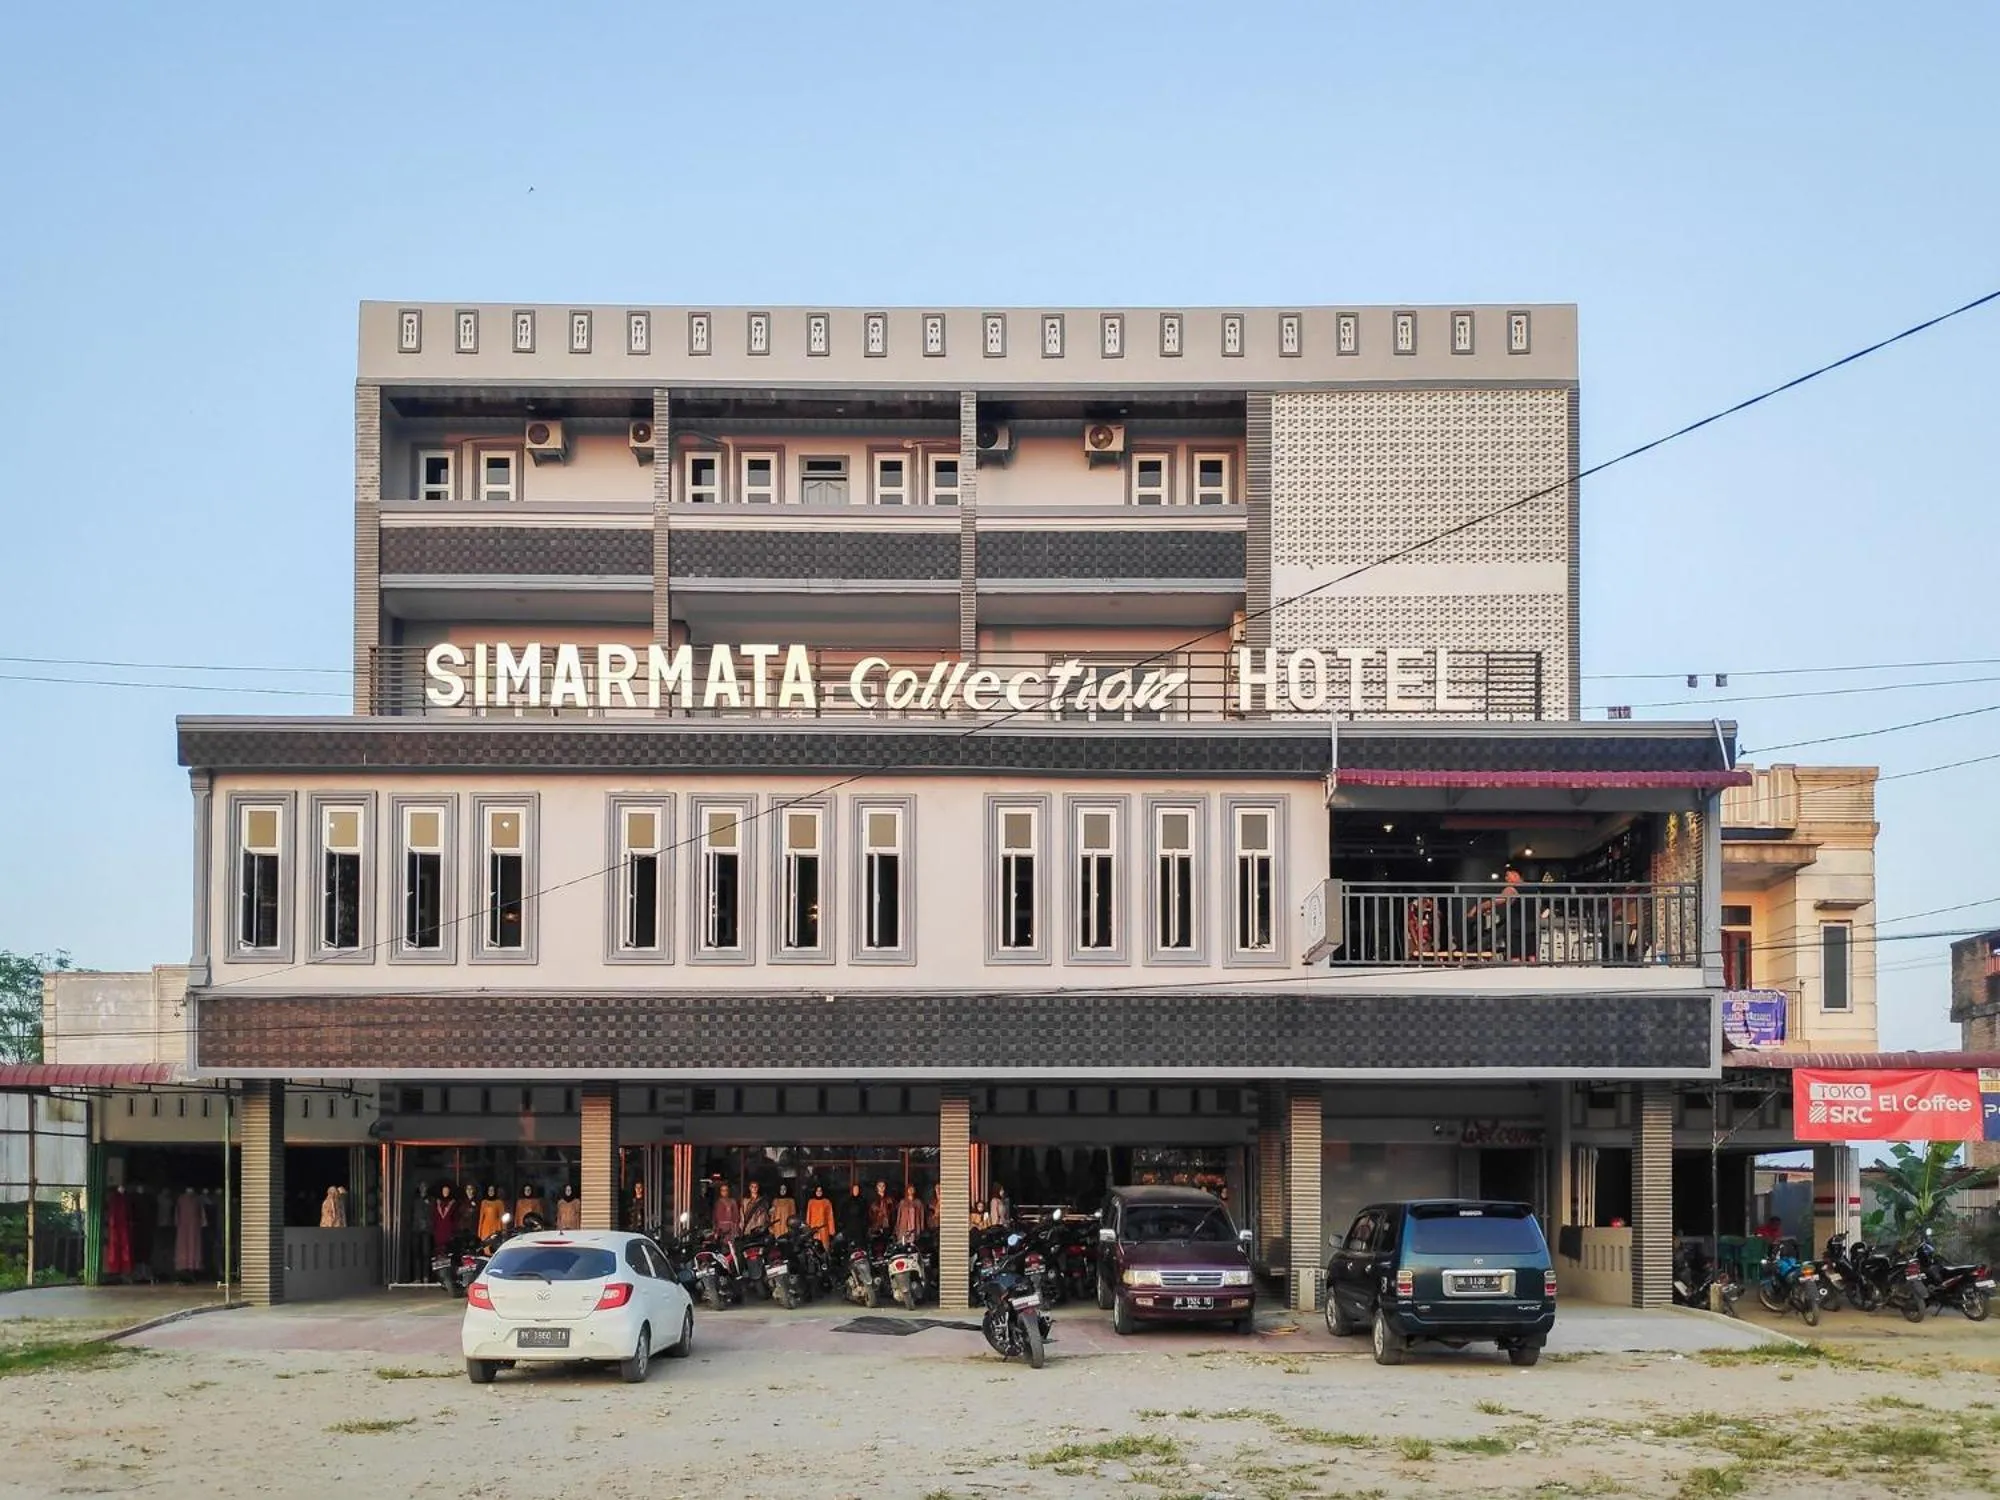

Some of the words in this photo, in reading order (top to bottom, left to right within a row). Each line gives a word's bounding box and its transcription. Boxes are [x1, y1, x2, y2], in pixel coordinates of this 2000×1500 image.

[425, 643, 818, 708] SIMARMATA
[849, 656, 1189, 711] Collection
[1238, 647, 1474, 712] HOTEL
[1817, 1084, 1867, 1099] TOKO
[1878, 1094, 1900, 1112] El
[1903, 1093, 1973, 1112] Coffee
[1829, 1105, 1873, 1124] SRC
